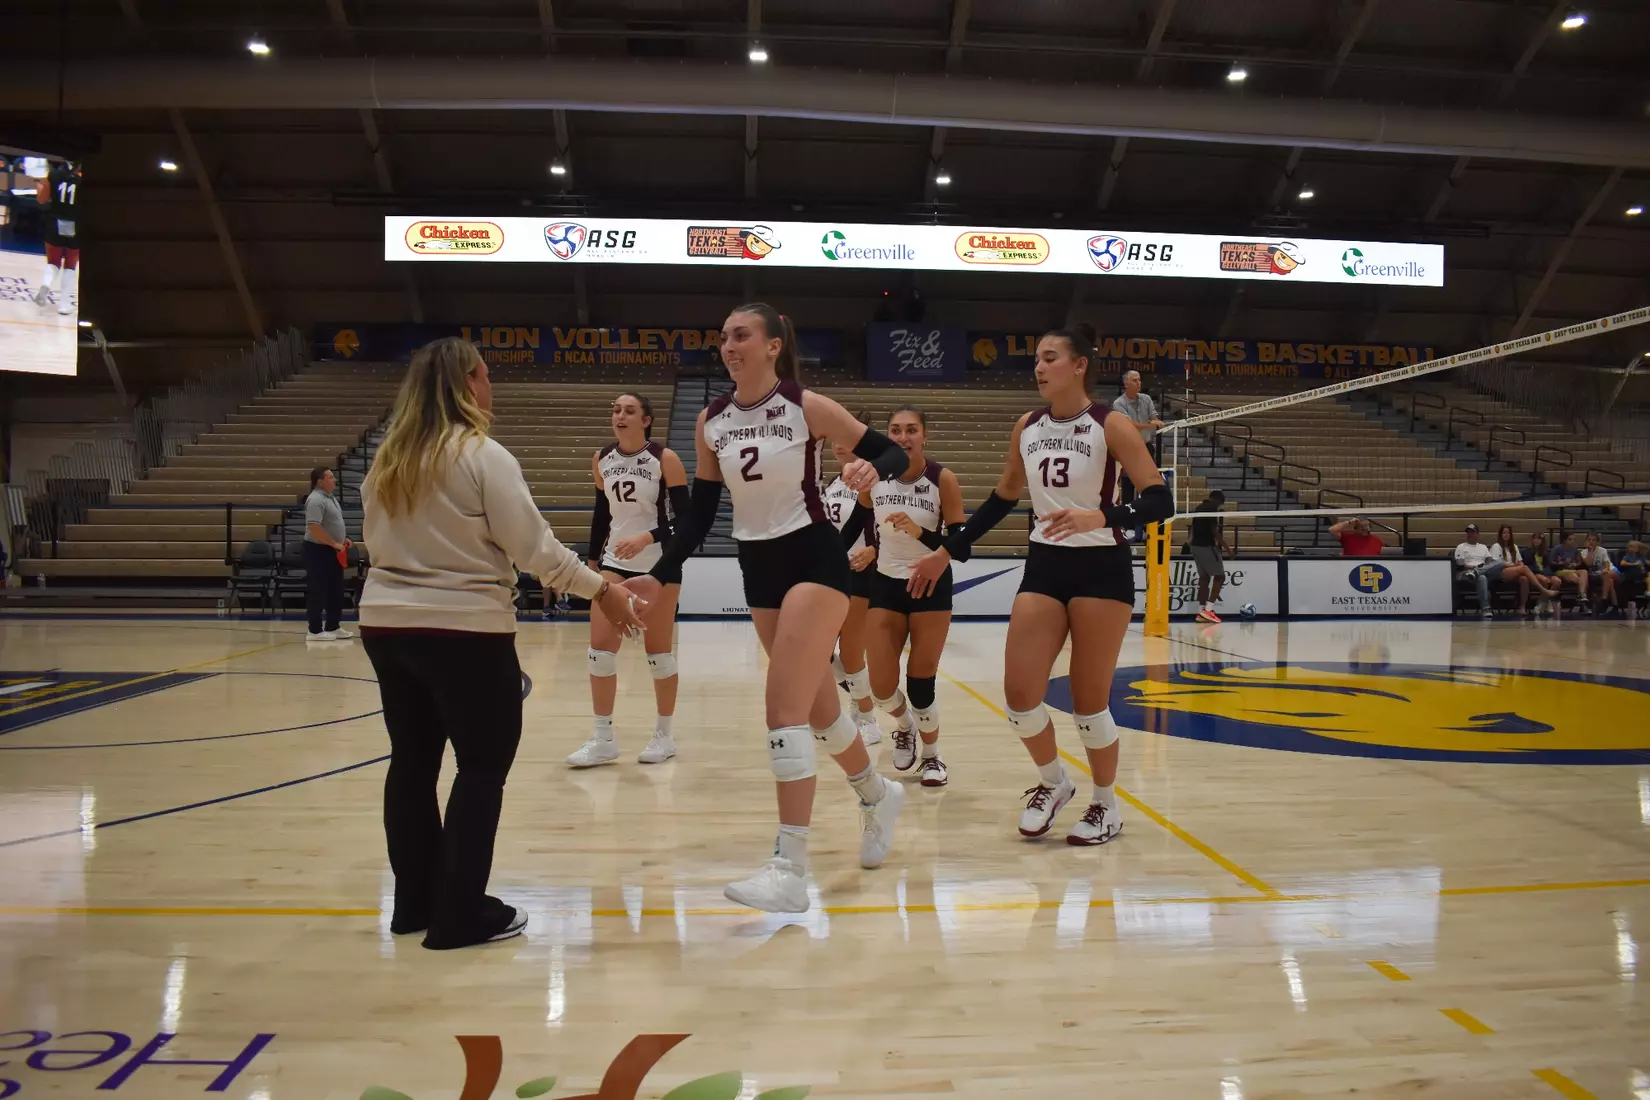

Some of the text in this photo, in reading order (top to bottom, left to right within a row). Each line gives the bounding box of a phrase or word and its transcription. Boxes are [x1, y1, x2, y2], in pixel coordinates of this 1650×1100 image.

[58, 182, 76, 205] 11
[420, 226, 490, 239] Chicken
[587, 230, 636, 248] ASG
[689, 236, 726, 247] TEXAS
[835, 242, 915, 260] Greenville
[969, 236, 1036, 250] Chicken
[1128, 243, 1173, 261] ASG
[1003, 252, 1038, 260] EXPRESS
[1222, 251, 1255, 262] TEXAS
[1353, 260, 1425, 278] Greenville
[1628, 310, 1646, 320] TEXAS
[461, 326, 722, 350] LION VOLLEYBA
[1568, 325, 1585, 335] TEXAS
[889, 329, 940, 355] Fix &
[1005, 335, 1035, 356] LI
[1099, 337, 1245, 362] WOMEN'S
[480, 350, 681, 365] IONSHIPS 6 NCAA TOURNAMENTS
[898, 350, 944, 373] Feed
[1193, 363, 1221, 376] NCAA
[1225, 363, 1299, 377] TOURNAMENTS
[714, 424, 793, 453] SOUTHERN ILLINOIS
[1028, 438, 1091, 457] SOUTHERN ILLINOIS
[740, 446, 763, 482] 2
[1038, 457, 1070, 488] 13
[612, 481, 637, 503] 12
[875, 494, 935, 513] SOUTHERN ILLINOIS
[1360, 566, 1383, 592] ET
[1331, 596, 1410, 605] EAST TEXAS A&M
